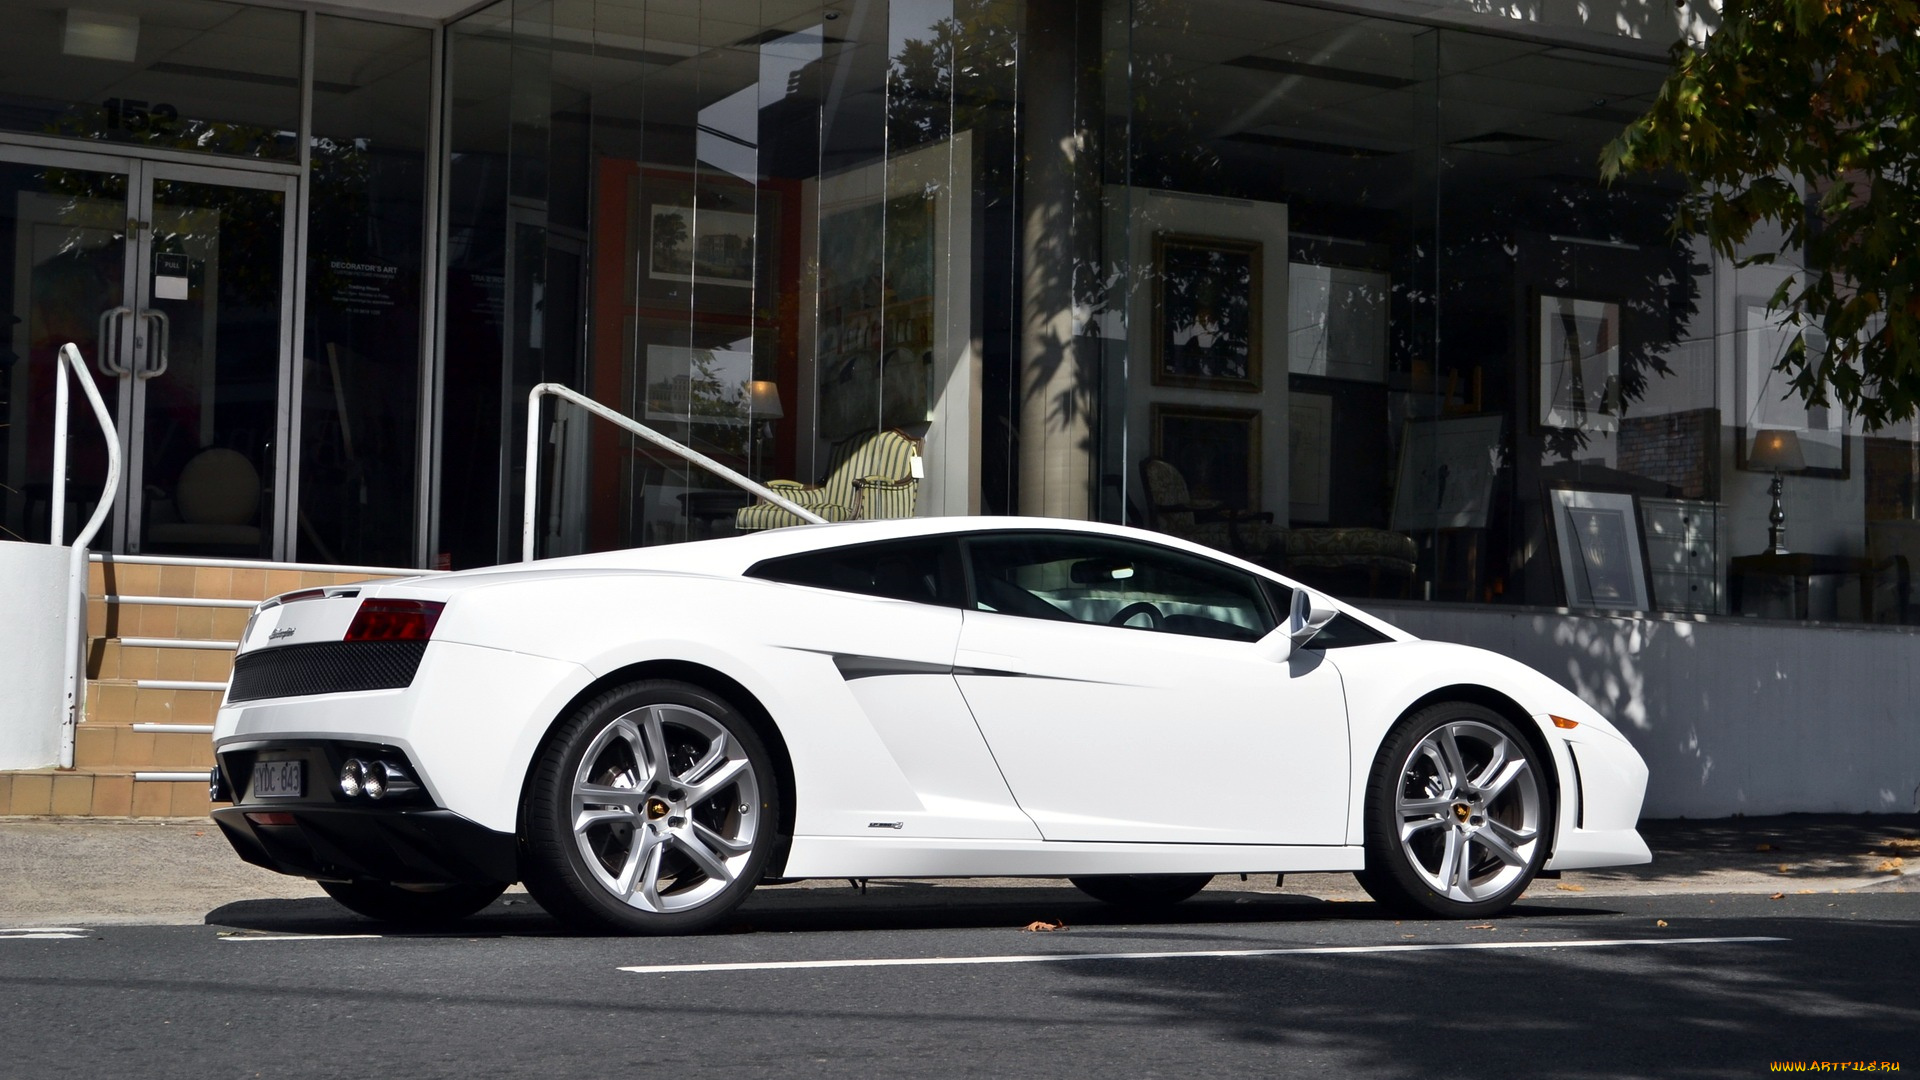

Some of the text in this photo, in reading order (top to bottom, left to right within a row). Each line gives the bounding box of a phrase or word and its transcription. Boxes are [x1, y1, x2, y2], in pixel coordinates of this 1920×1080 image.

[103, 97, 178, 135] 152
[164, 261, 180, 269] PULL
[330, 261, 398, 274] DECORATOR'S ART
[281, 765, 299, 791] 843
